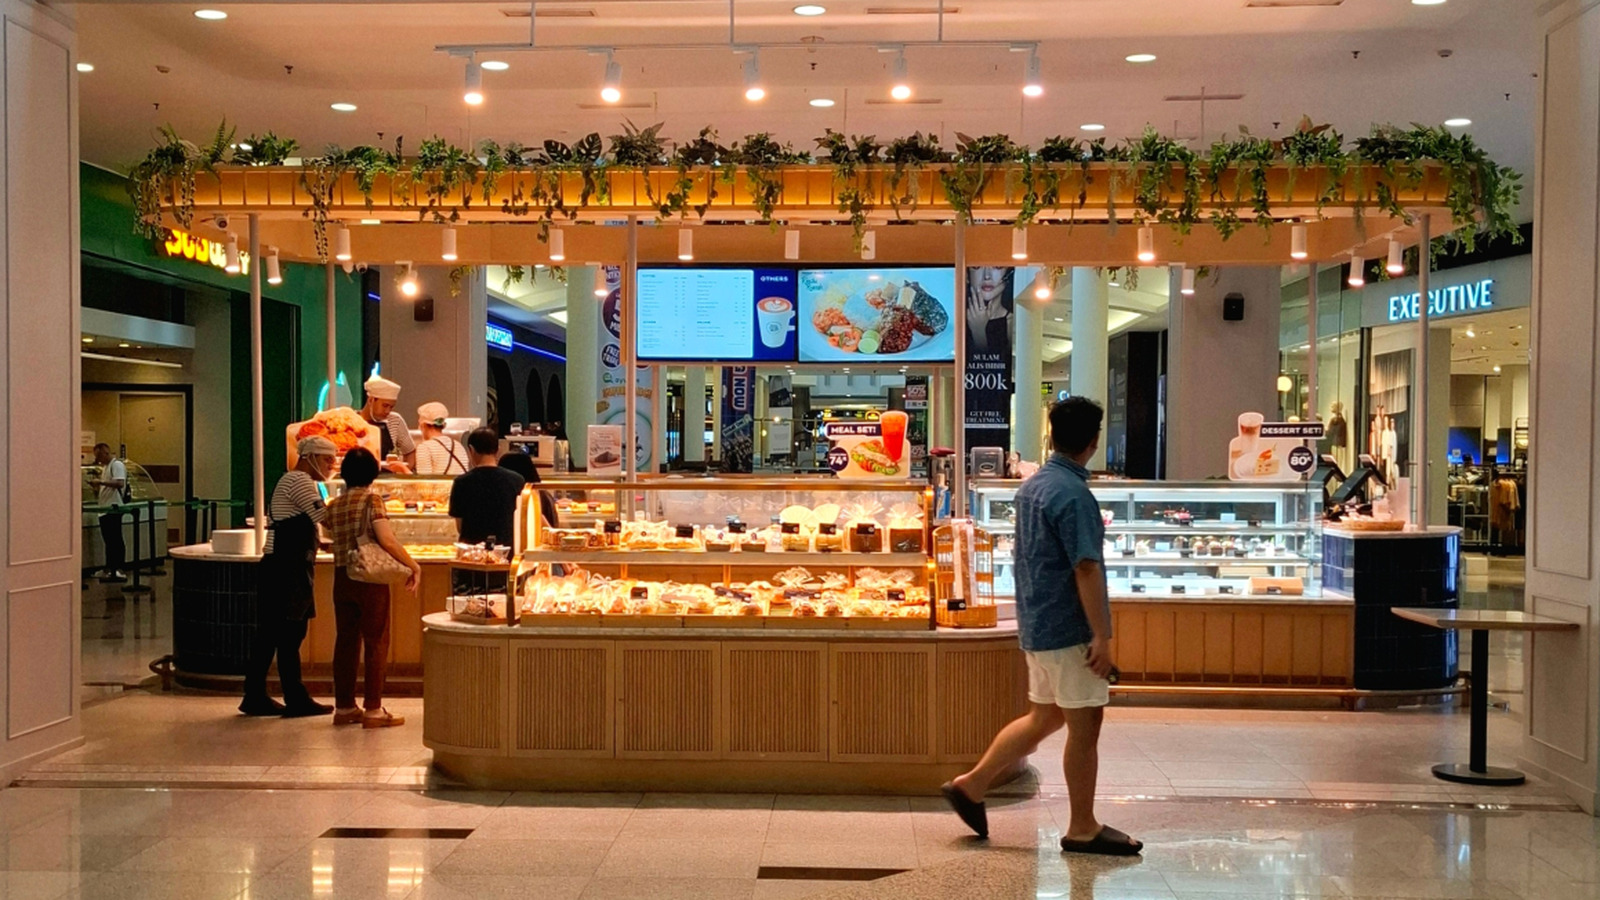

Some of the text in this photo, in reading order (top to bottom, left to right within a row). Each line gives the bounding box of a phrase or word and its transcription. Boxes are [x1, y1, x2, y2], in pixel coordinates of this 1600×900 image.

[165, 229, 250, 275] SUBWY
[733, 376, 747, 410] NOW
[964, 373, 1008, 390] 800k
